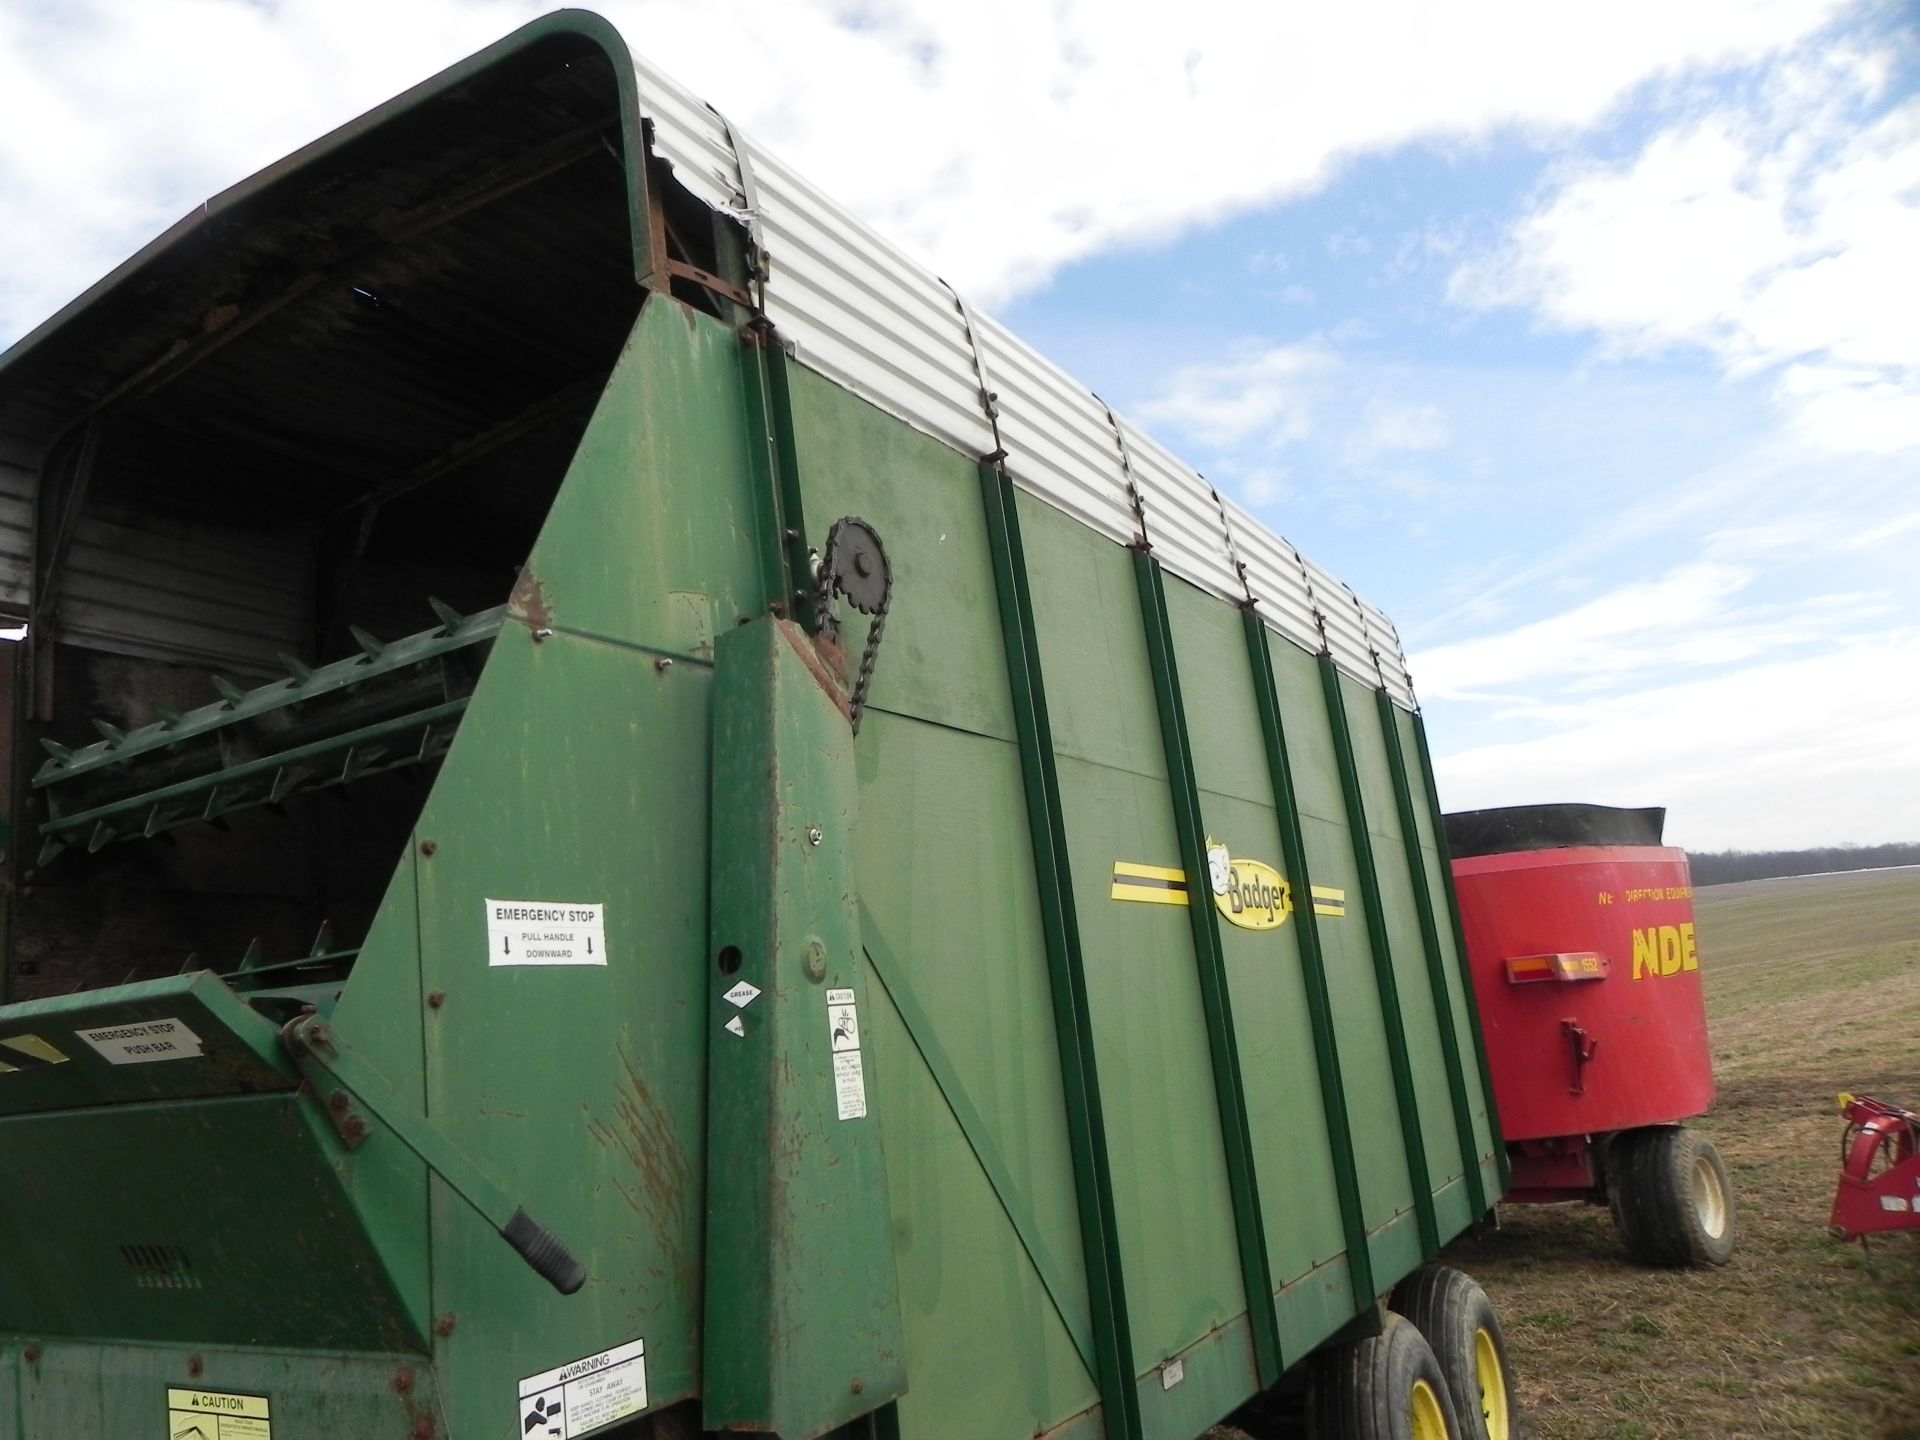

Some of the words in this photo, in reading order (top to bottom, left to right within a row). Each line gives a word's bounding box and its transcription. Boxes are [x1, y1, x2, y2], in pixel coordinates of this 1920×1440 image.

[1228, 867, 1285, 922] Badger
[496, 908, 566, 921] EMERGENCY
[569, 910, 595, 922] STOP
[522, 932, 541, 941] PULL
[544, 933, 574, 942] HANDLE
[526, 949, 573, 958] DOWNWARD
[1632, 922, 1698, 980] NDE
[730, 989, 753, 998] GREASE
[88, 1026, 150, 1042] EMERGENCY
[148, 1023, 177, 1035] STOP
[123, 1044, 154, 1055] PUSH
[151, 1041, 177, 1053] BAR
[566, 1353, 610, 1377] WARNING
[589, 1386, 603, 1397] STAY
[606, 1378, 623, 1391] AWAY
[202, 1395, 244, 1410] CAUTION
